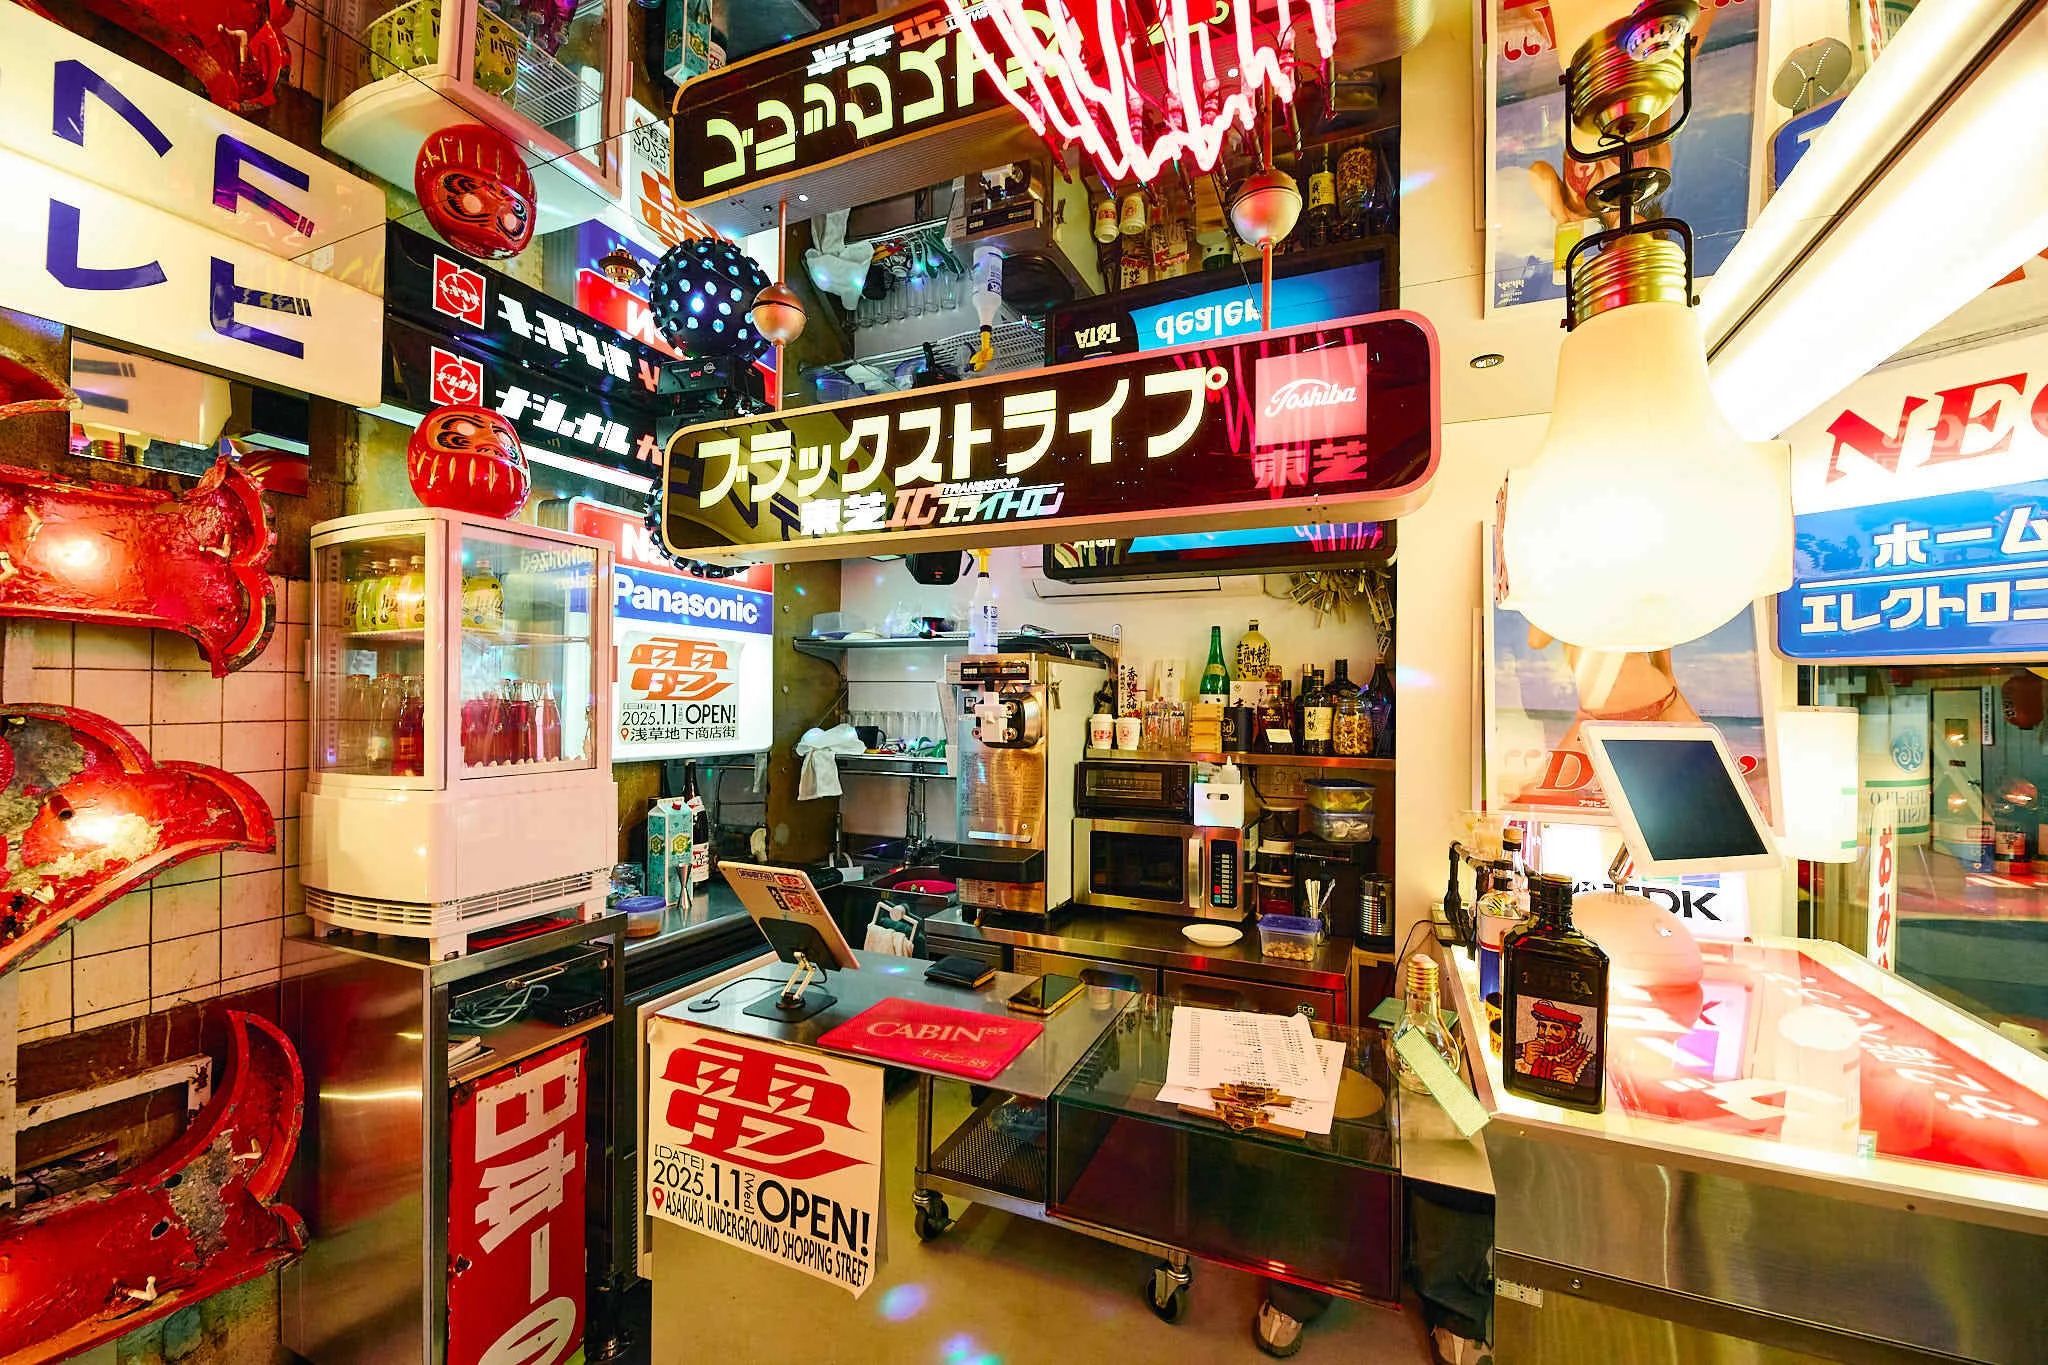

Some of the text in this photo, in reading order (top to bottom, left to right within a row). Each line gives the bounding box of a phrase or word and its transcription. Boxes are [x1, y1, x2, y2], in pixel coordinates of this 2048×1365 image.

[1265, 378, 1357, 418] Toshiba
[699, 366, 1229, 509] ブラックストライプ
[1825, 372, 2048, 485] NE
[1254, 441, 1368, 489] 東芝
[800, 491, 887, 537] 東芝
[614, 572, 760, 625] Panasonic
[630, 726, 736, 742] 浅草地下商店街
[685, 703, 736, 725] OPEN!
[665, 1190, 869, 1288] ASAKUSA UNDERGROUND SHOPPING STREET
[757, 1179, 871, 1257] OPEN!
